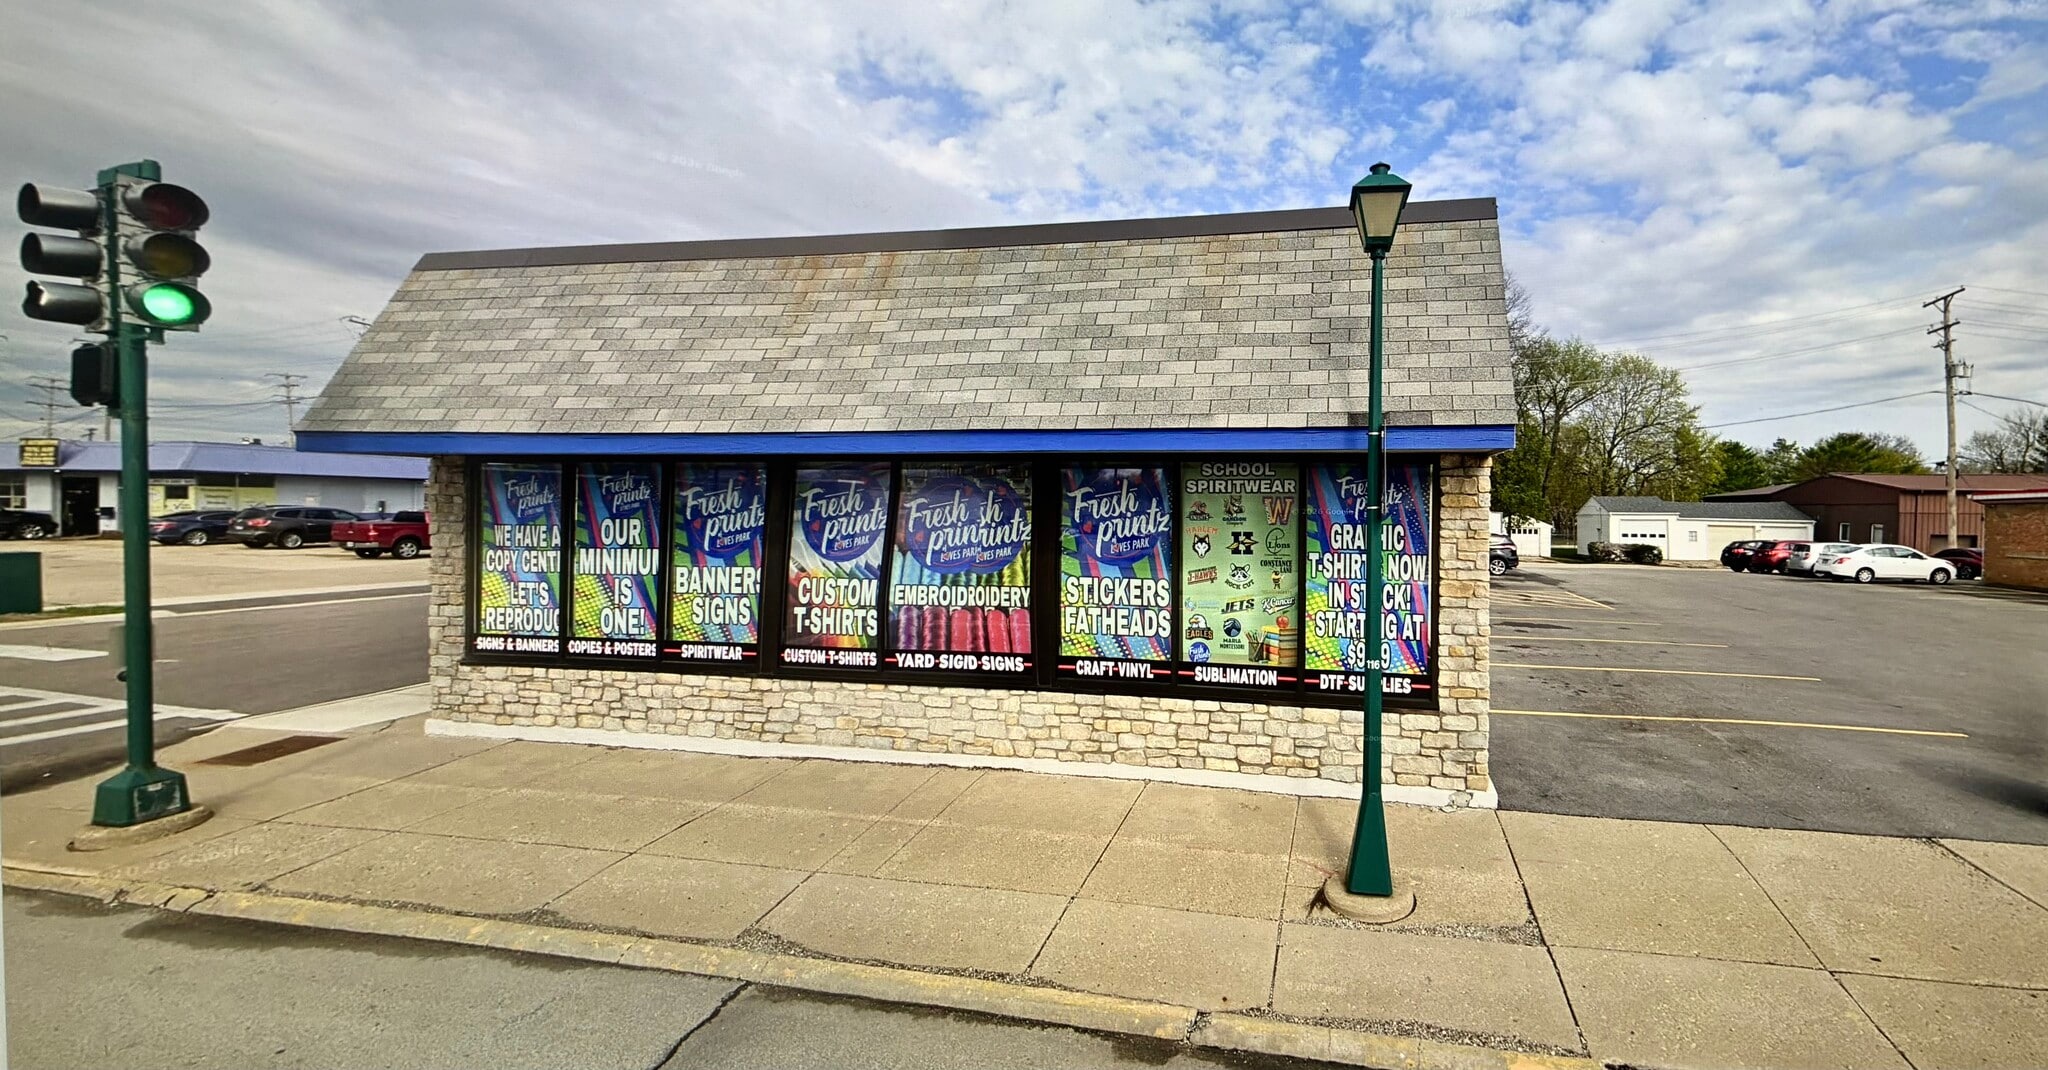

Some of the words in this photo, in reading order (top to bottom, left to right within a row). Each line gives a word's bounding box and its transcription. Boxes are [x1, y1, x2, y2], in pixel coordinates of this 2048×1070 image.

[1201, 462, 1275, 477] SCHOOL
[504, 475, 538, 499] Fresh
[599, 471, 634, 495] Fresh
[1185, 479, 1296, 494] SPIRITWEAR
[518, 485, 554, 518] printz
[613, 481, 651, 513] printz
[680, 479, 742, 520] Fresh
[799, 482, 864, 522] Fresh
[1067, 479, 1139, 523] Fresh
[704, 495, 764, 551] printz
[904, 490, 969, 533] Fresh
[494, 525, 512, 547] WE
[515, 525, 547, 547] HAVE
[551, 525, 561, 547] A
[600, 518, 642, 545] OUR
[821, 497, 887, 554] printz
[1095, 498, 1170, 557] printz
[853, 535, 869, 546] PARK
[1132, 538, 1150, 549] PARK
[486, 550, 518, 571] COPY
[995, 547, 1012, 559] PARK
[1387, 554, 1427, 581] NOW
[510, 582, 549, 605] LET'S
[614, 578, 632, 605] IS
[798, 577, 877, 606] CUSTOM
[1066, 576, 1170, 607] STICKERS
[1225, 579, 1241, 589] ROCK
[1242, 579, 1255, 589] CUT
[1221, 598, 1255, 614] JETS
[1328, 582, 1345, 608] IN
[1350, 583, 1411, 611] STCK!
[601, 608, 645, 635] ONE!
[692, 597, 751, 624] SIGNS
[794, 606, 877, 636] T-SHIRTS
[1065, 606, 1171, 638] FATHEADS
[1186, 629, 1213, 640] EAGLES
[1402, 614, 1424, 640] AT
[476, 636, 504, 651] SIGNS
[506, 638, 515, 650] &
[516, 638, 559, 652] BANNERS
[568, 640, 602, 654] COPIES
[604, 641, 612, 654] &
[614, 643, 656, 656] POSTERS
[681, 644, 742, 660] SPIRITWEAR
[784, 648, 826, 664] CUSTOM
[828, 650, 877, 666] T-SHIRTS
[895, 653, 935, 668] YARD
[981, 656, 1025, 672] SIGNS
[1366, 660, 1380, 670] 116
[1076, 660, 1115, 677] CRAFT
[1118, 662, 1154, 679] VINYL
[1195, 666, 1277, 685] SUBLIMATION
[1320, 674, 1345, 690] DTF
[1348, 675, 1412, 694] SULIES
